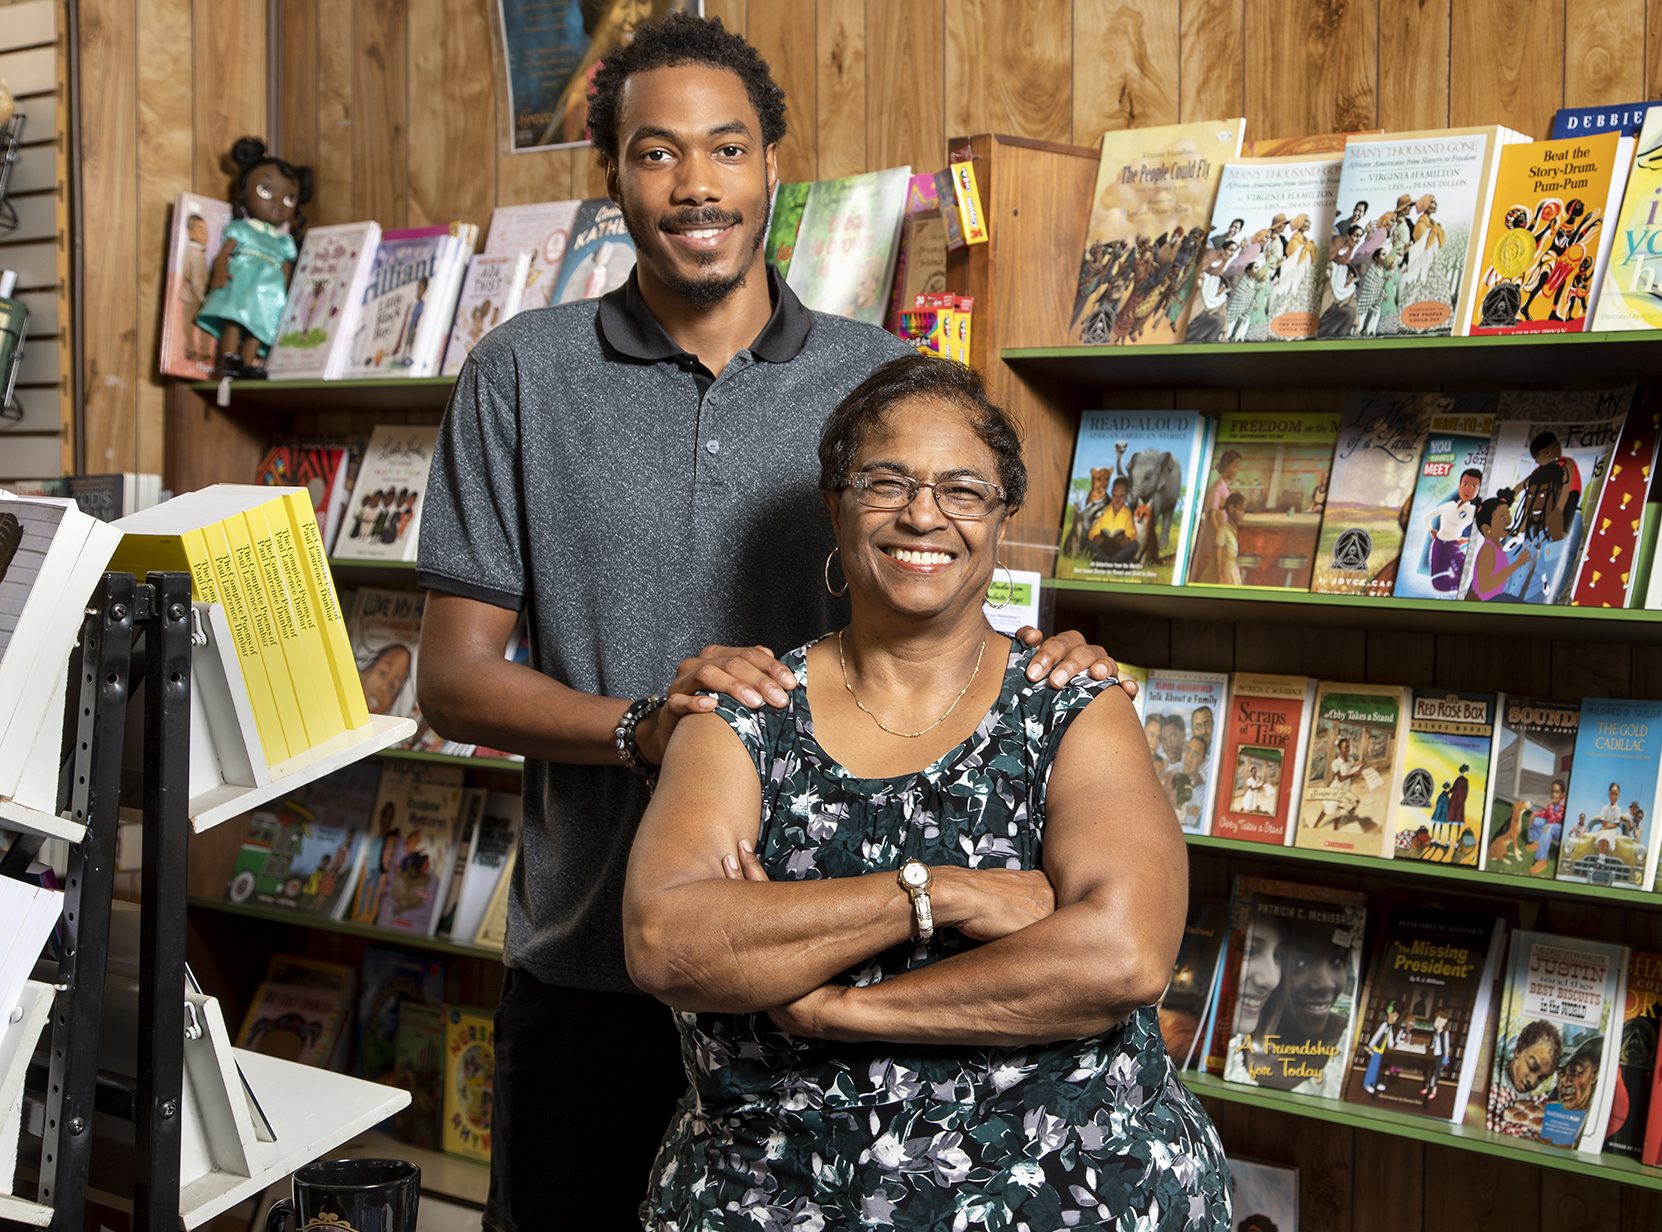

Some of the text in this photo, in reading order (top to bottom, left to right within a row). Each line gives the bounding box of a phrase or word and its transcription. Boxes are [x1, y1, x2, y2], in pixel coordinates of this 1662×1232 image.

[1567, 111, 1643, 130] DEBBIE
[1350, 140, 1477, 159] MANY THOUSAND GONE
[1544, 146, 1591, 161] Beat the
[1407, 158, 1420, 167] from
[1452, 154, 1477, 162] Freedom
[1121, 158, 1212, 184] The People Could Fly
[1229, 166, 1323, 180] MANY THOUSAND
[1368, 168, 1462, 182] VIRGINIA HAMILTON
[1529, 162, 1598, 179] Story-Drum,
[1388, 182, 1403, 190] LEO
[1413, 180, 1437, 189] DIANE
[1438, 178, 1468, 188] DILLON
[1534, 177, 1588, 192] Pum-Pum
[1246, 190, 1335, 201] VIRGINIA HAMILTON
[1090, 416, 1189, 431] READ-ALOUD
[1231, 419, 1304, 432] FREEDOM
[1430, 440, 1452, 453] YOU
[1424, 463, 1453, 477] MEET
[194, 563, 206, 585] Paul
[201, 559, 210, 578] The
[281, 528, 291, 547] The
[288, 547, 303, 587] Complete
[301, 588, 312, 620] Poems
[302, 523, 334, 622] Paul Laurence Dunbar
[242, 544, 252, 562] The
[249, 562, 265, 607] Complete
[262, 606, 274, 637] Poems
[257, 540, 290, 640] Paul Laurence Dunbar
[264, 537, 273, 555] The
[270, 555, 285, 598] Complete
[282, 598, 295, 629] Poems
[275, 531, 307, 631] Paul Laurence Dunbar
[215, 556, 249, 658] Paul Laurence Dunbar
[222, 553, 232, 571] The
[228, 572, 245, 613] Complete
[241, 615, 252, 645] Poems
[236, 547, 269, 648] Paul Laurence Dunbar
[1149, 691, 1162, 701] Talk
[1165, 692, 1186, 703] About
[1194, 695, 1218, 707] Family
[1239, 700, 1287, 732] Scraps
[1324, 709, 1347, 721] Abby
[1347, 710, 1366, 721] Takes
[1372, 711, 1395, 723] Stand
[1417, 701, 1485, 720] RED ROSE BOX
[1508, 705, 1579, 728] SOUND
[1239, 722, 1292, 746] of Time
[1511, 723, 1541, 732] WILLIAM
[1598, 719, 1649, 738] THE GOLD
[1594, 736, 1646, 752] CADILLAC
[1238, 818, 1257, 832] Takes
[1264, 820, 1284, 835] Stand
[1257, 902, 1296, 919] PATRICIA
[1410, 939, 1469, 965] Missing
[1531, 957, 1606, 982] JUSTIN
[1529, 982, 1601, 1006] BEST BISCUITS
[1540, 998, 1587, 1019] in the WORLD
[1237, 1034, 1341, 1063] A Friendship
[1248, 1057, 1323, 1085] for Today
